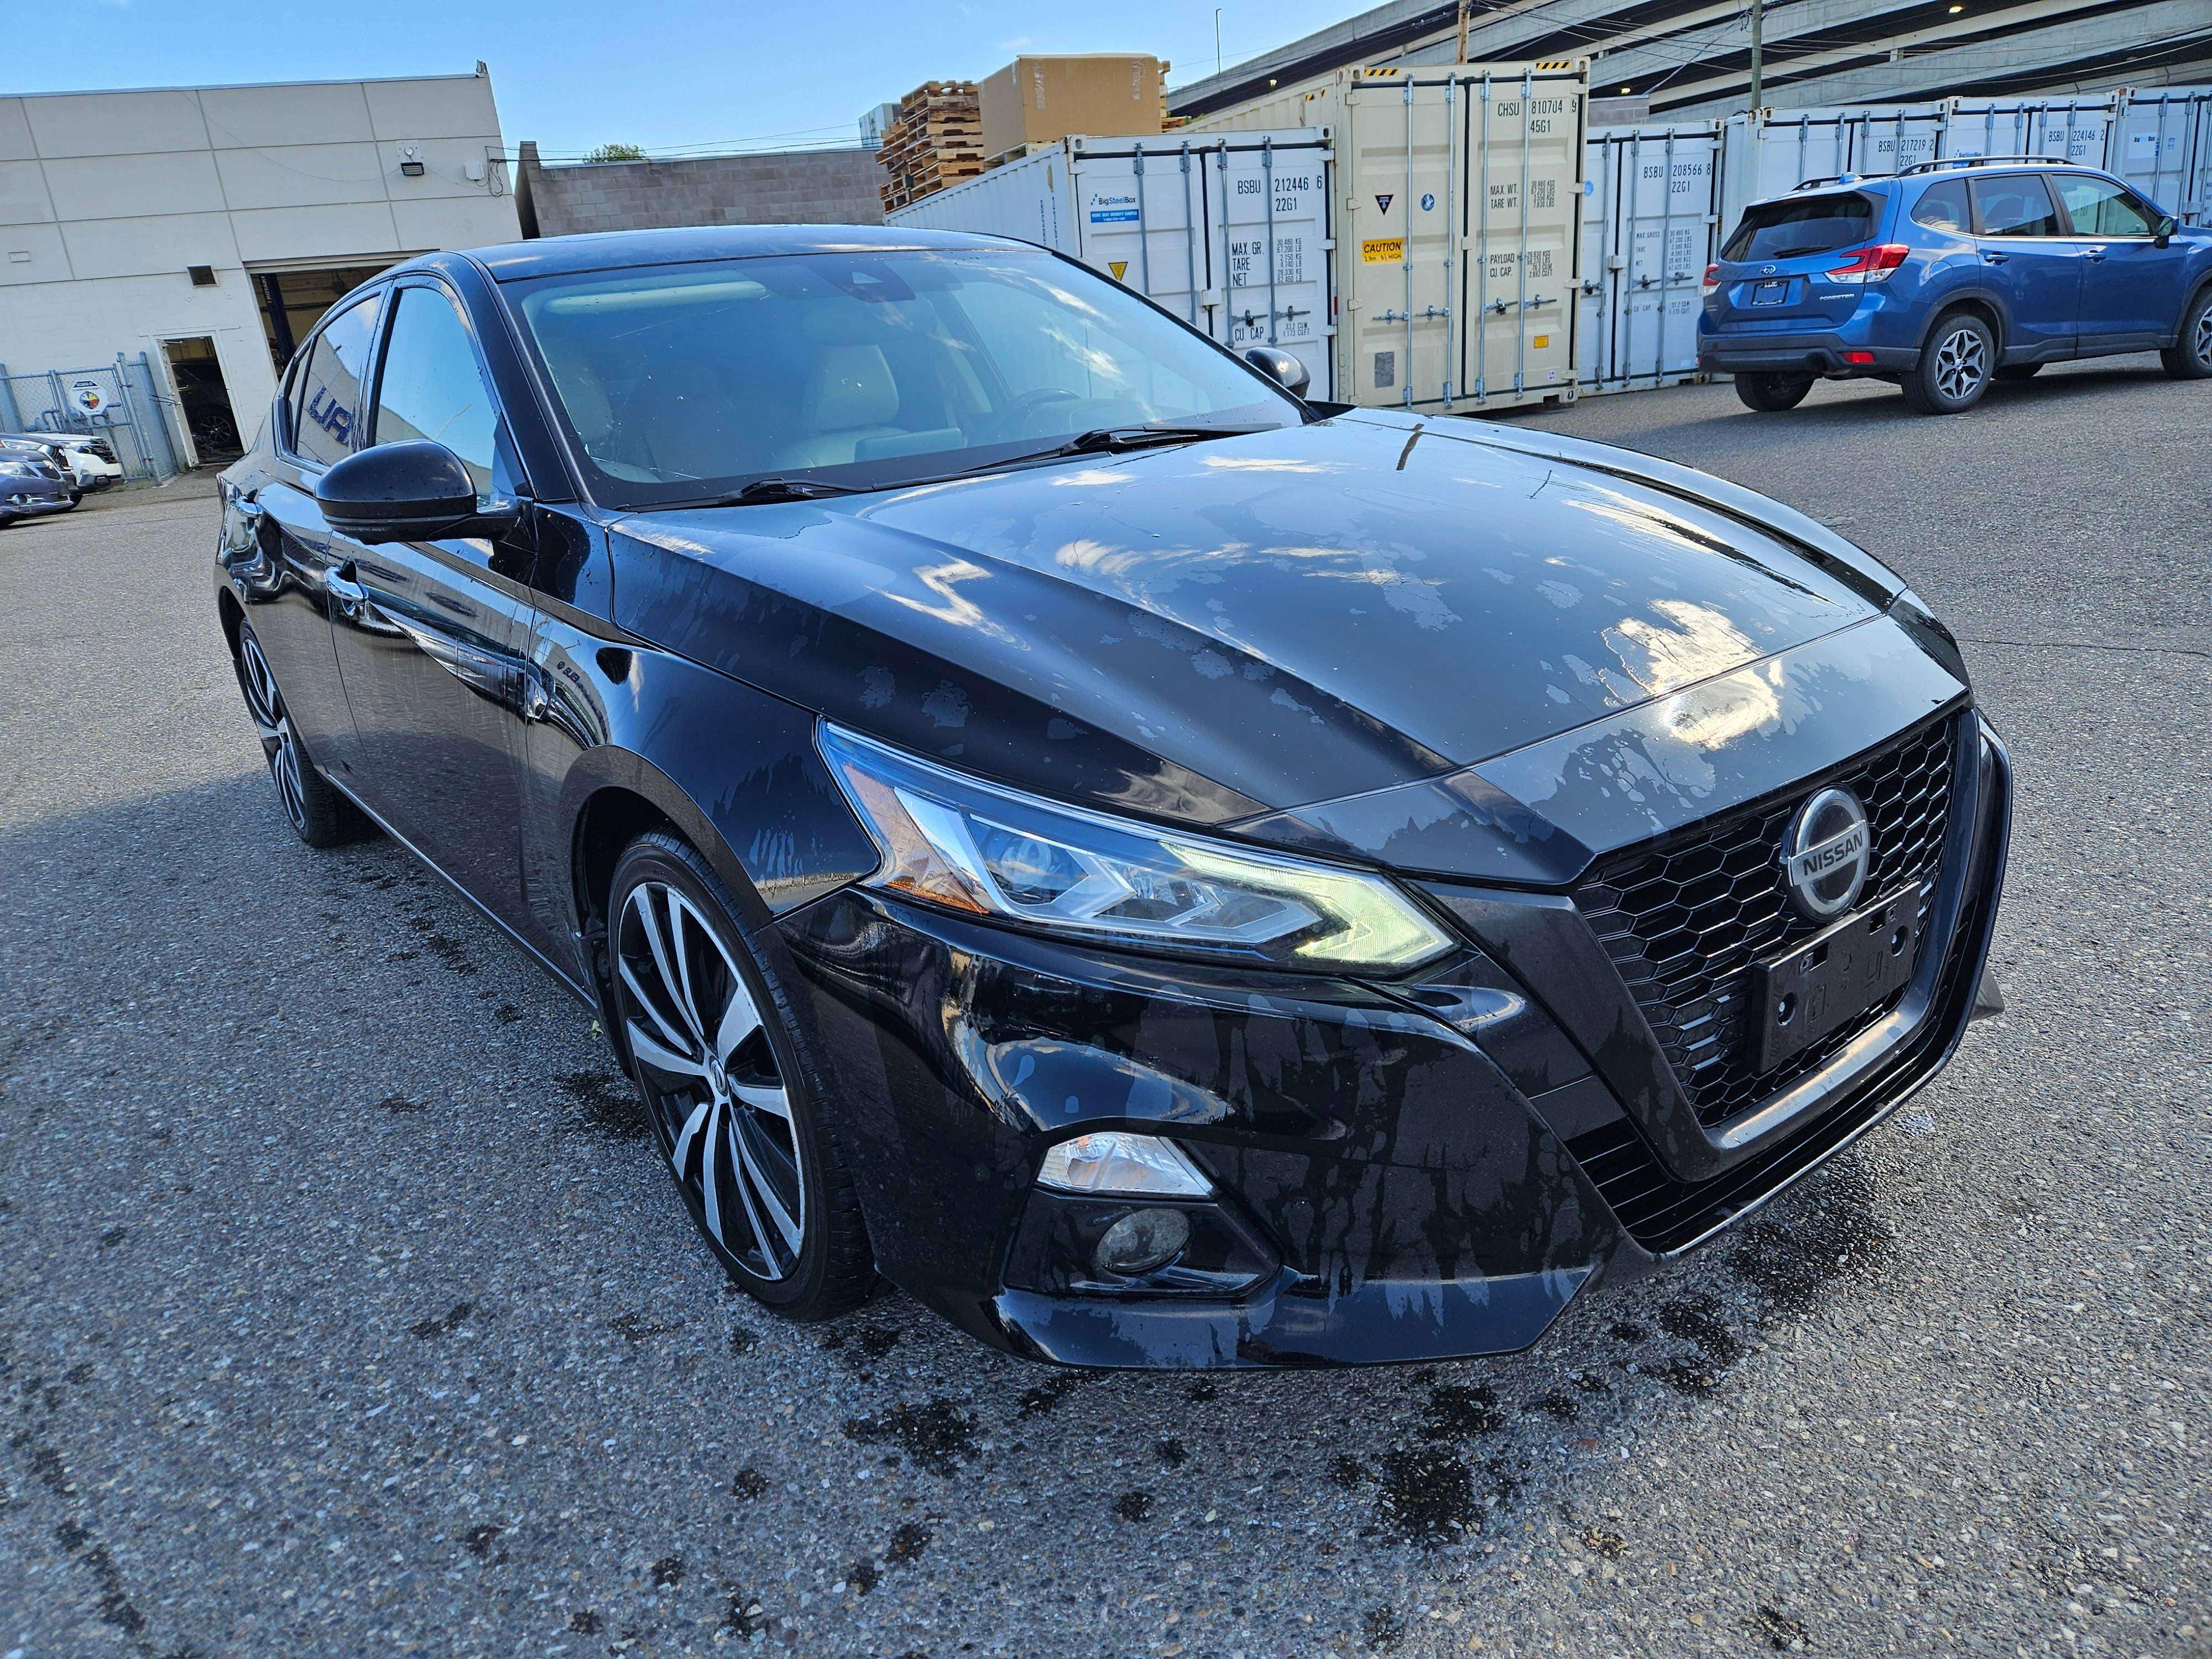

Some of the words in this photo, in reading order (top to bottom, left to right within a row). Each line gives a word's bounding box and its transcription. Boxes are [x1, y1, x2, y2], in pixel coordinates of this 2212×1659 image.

[1498, 102, 1519, 117] CHSU
[1531, 100, 1563, 114] 810704
[1572, 99, 1577, 112] 9
[1530, 119, 1551, 133] 45G1
[2049, 131, 2064, 142] BSBU
[2073, 130, 2096, 142] 224146
[2101, 129, 2105, 141] 2
[1879, 140, 1896, 153] BSBU
[1901, 139, 1927, 151] 217219
[1929, 139, 1934, 150] 2
[2071, 145, 2086, 156] 22G1
[1900, 155, 1917, 166] 22G1
[1644, 166, 1663, 179] BSBU
[1672, 164, 1702, 176] 208566
[1706, 163, 1712, 175] 8
[1238, 180, 1261, 194] BSBU
[1275, 177, 1310, 192] 212446
[1317, 175, 1323, 189] 6
[1507, 184, 1519, 194] WT.
[1671, 180, 1691, 193] 22G1
[1099, 197, 1136, 206] BigSteelBox
[1275, 197, 1297, 212] 22G1
[1491, 199, 1505, 209] TARE
[1507, 197, 1519, 207] WT.
[1232, 242, 1250, 256] MAX.
[1252, 242, 1265, 255] GR.
[1364, 242, 1401, 253] CAUTION
[1233, 258, 1250, 271] TARE
[1490, 253, 1515, 264] PAYLOAD
[1233, 273, 1247, 286] NET
[1234, 328, 1247, 341] CU.
[1250, 326, 1267, 340] CAP.
[1803, 831, 1863, 876] NISSAN
